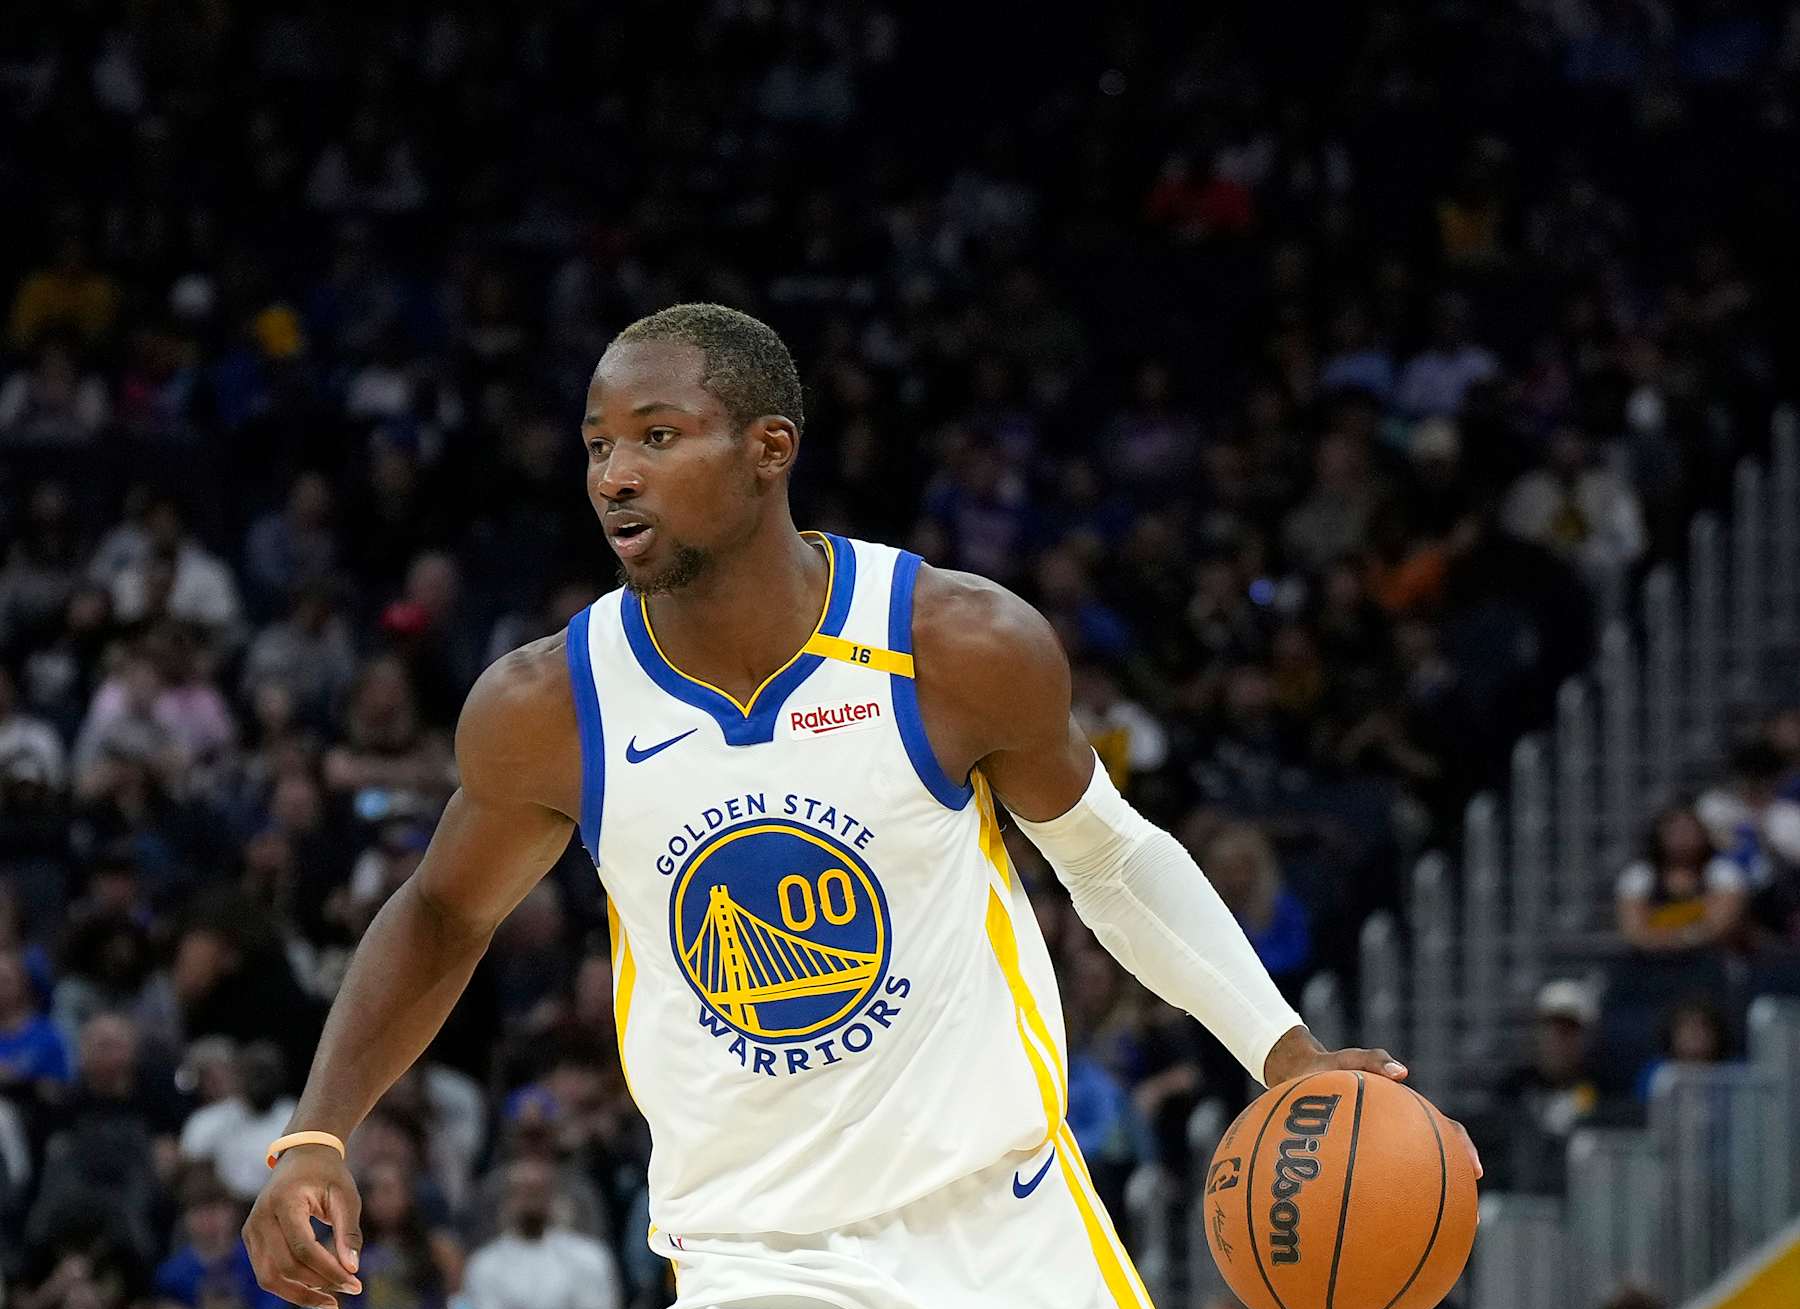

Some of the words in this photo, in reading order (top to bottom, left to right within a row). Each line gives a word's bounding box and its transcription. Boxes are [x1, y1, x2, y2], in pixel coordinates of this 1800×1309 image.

[850, 645, 872, 664] 16
[790, 702, 880, 731] Rakuten
[656, 793, 767, 876] GOLDEN
[783, 794, 875, 850] STATE
[777, 868, 857, 932] 00
[699, 975, 911, 1077] WARRIORS
[1269, 1093, 1343, 1267] Wilson
